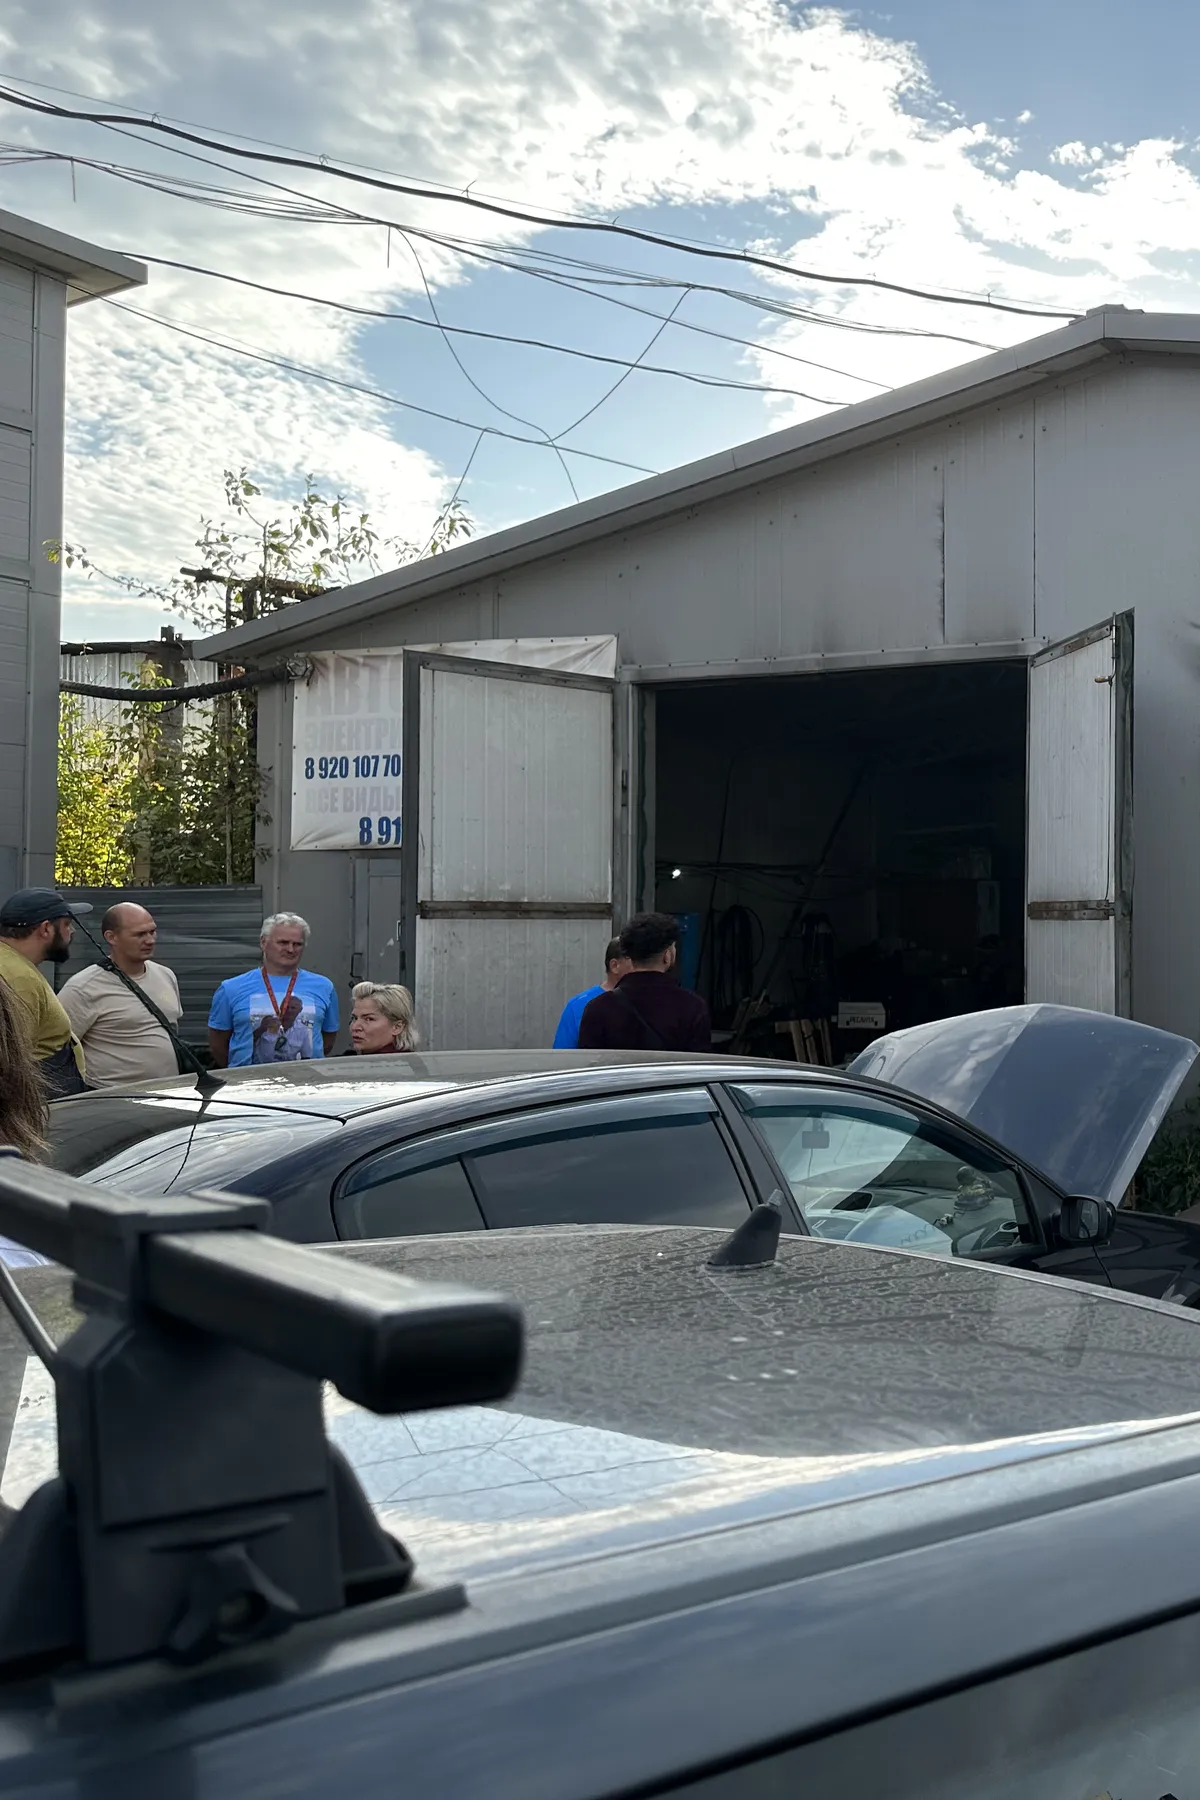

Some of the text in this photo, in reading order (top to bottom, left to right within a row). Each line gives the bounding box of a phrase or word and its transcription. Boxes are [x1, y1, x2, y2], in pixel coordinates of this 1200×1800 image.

[305, 754, 401, 779] 8 920 107 70
[306, 786, 402, 816] ВСЕ ВИДЫ
[359, 817, 372, 846] 8
